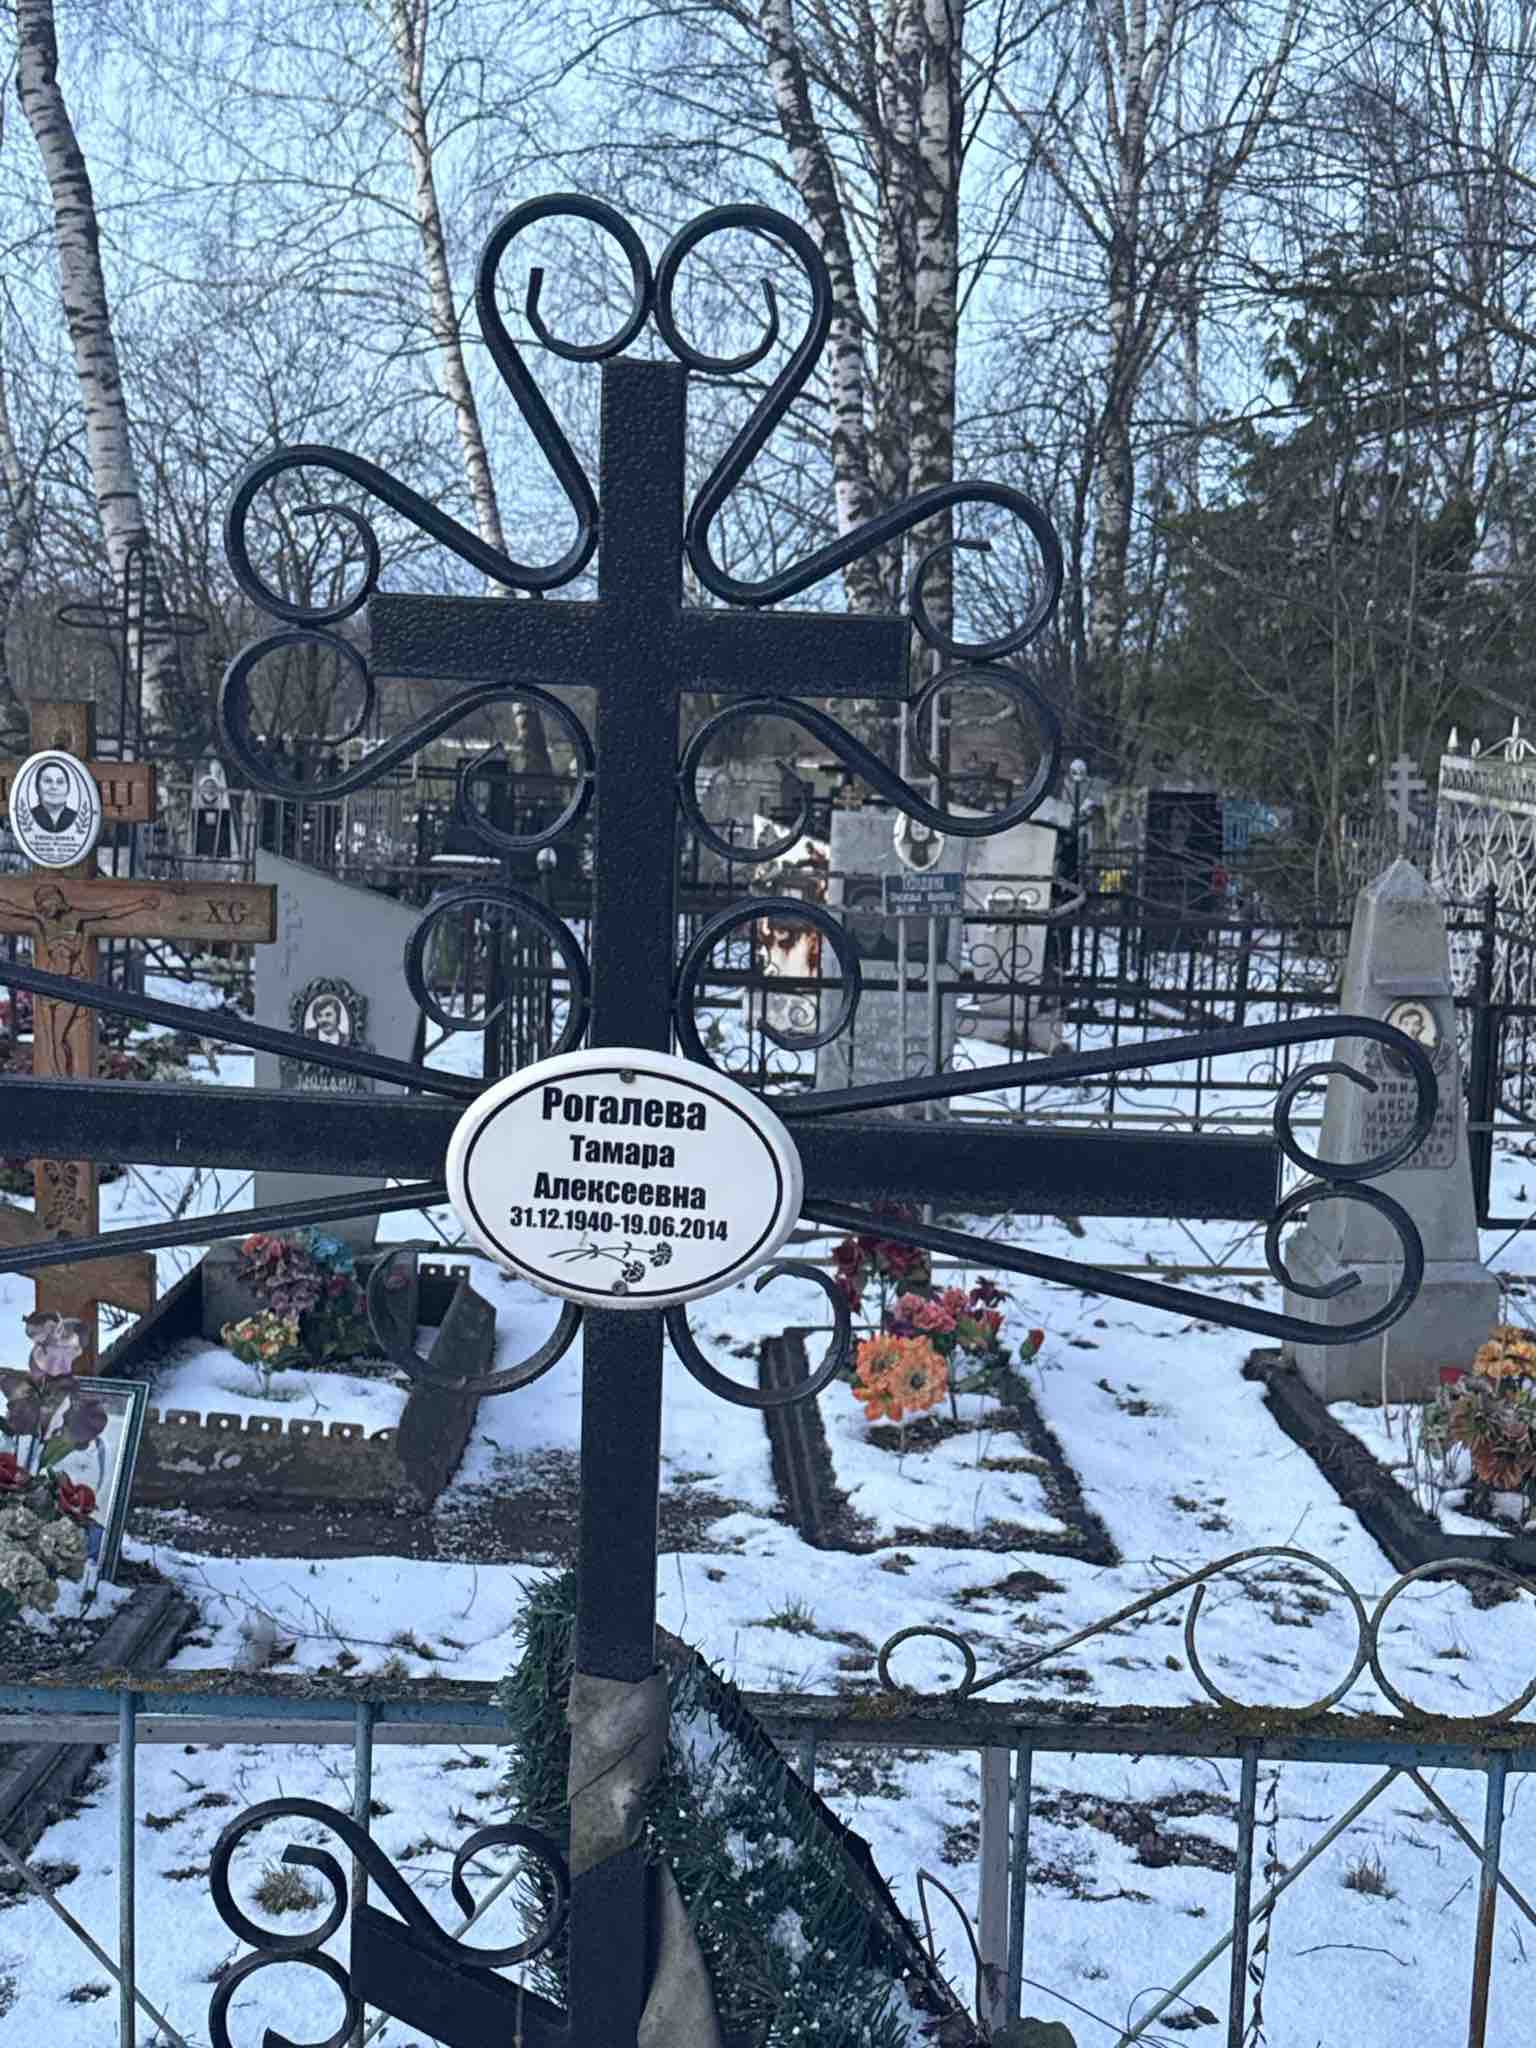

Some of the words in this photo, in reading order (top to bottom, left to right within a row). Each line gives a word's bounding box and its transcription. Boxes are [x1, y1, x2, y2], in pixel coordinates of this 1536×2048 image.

[541, 1086, 707, 1131] Рогалева
[570, 1134, 675, 1168] Тамара
[533, 1172, 706, 1210] Алексеевна
[510, 1206, 728, 1241] 31.12.1940-19.06.2014
